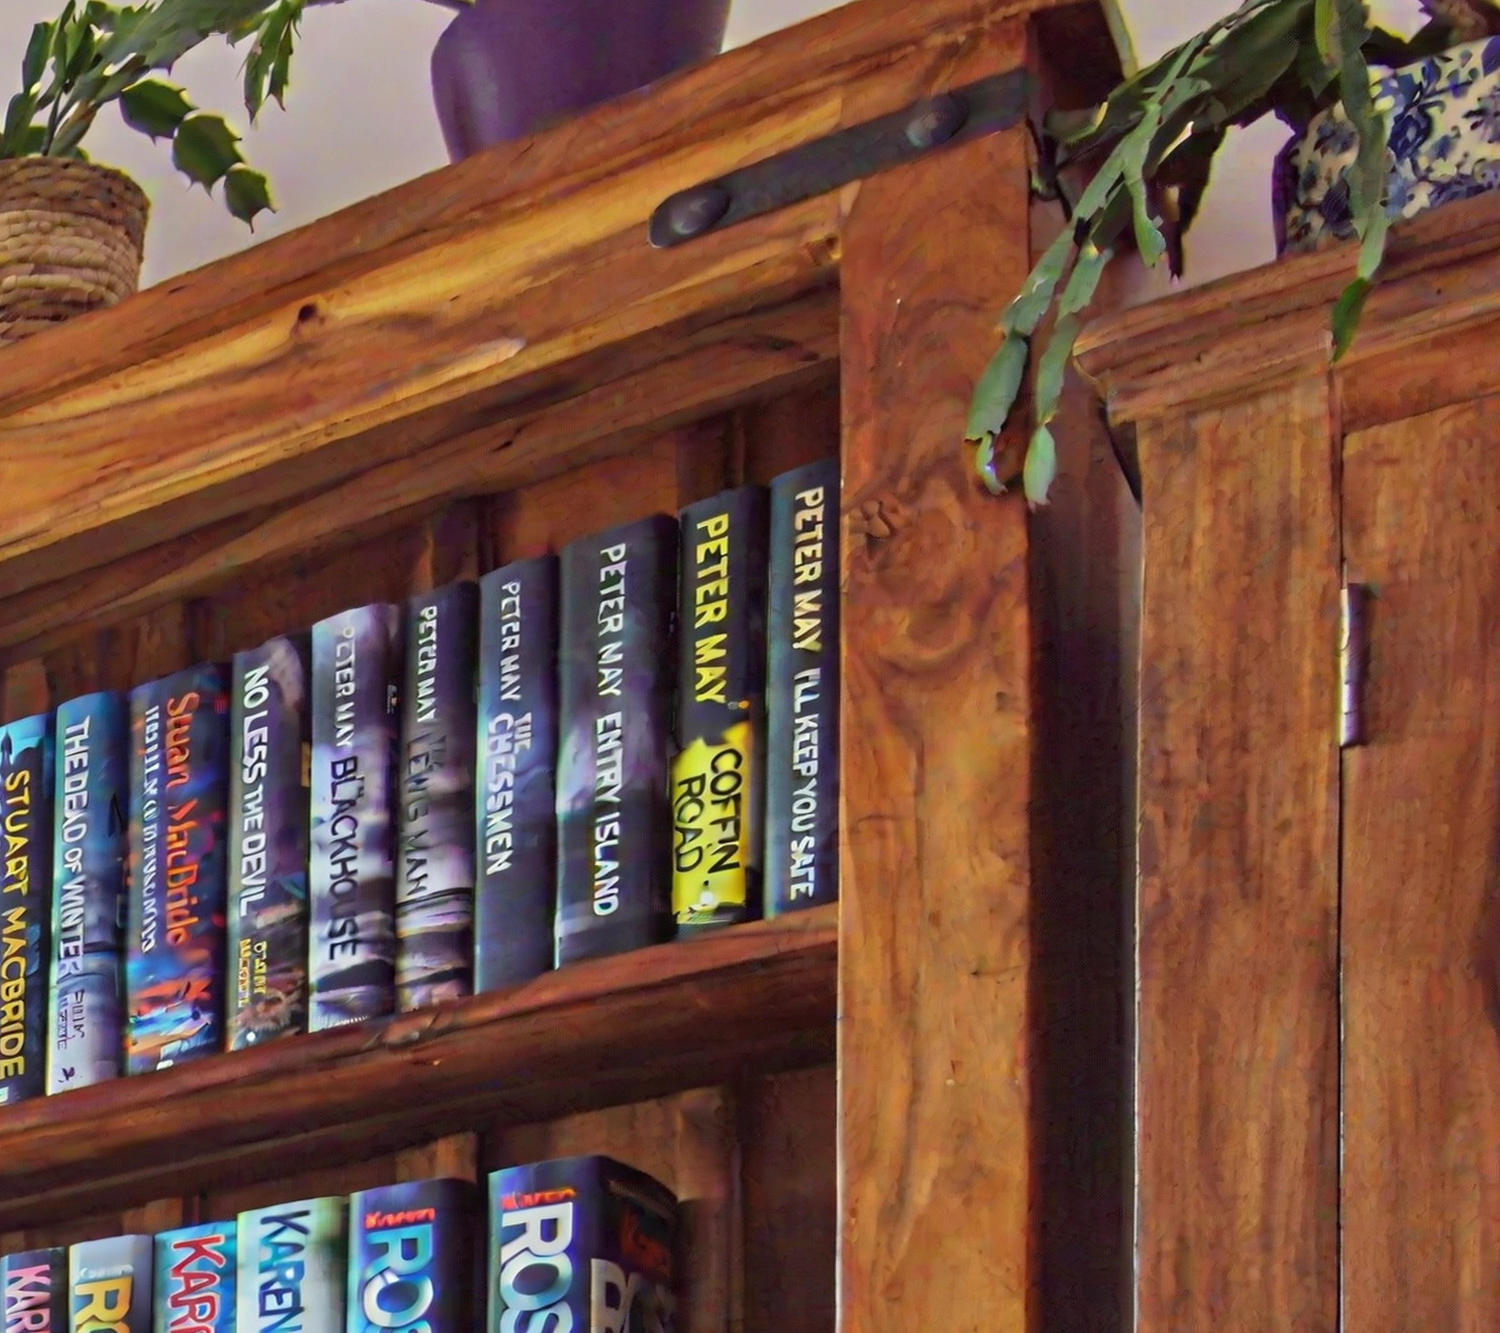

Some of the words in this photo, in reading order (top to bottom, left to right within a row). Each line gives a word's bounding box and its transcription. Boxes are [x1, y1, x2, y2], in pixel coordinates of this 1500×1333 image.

[695, 513, 729, 623] PETER
[794, 487, 824, 581] PETER
[500, 582, 521, 652] PETER
[598, 543, 626, 635] PETER
[792, 589, 822, 652] MAY
[243, 665, 269, 708] NO
[416, 680, 437, 724] MAY
[499, 656, 521, 701] MAY
[597, 641, 623, 697] MAY
[694, 633, 727, 704] MAY
[65, 716, 90, 768] THE
[243, 715, 267, 784] LESS
[792, 715, 818, 776] KEEP
[63, 772, 88, 842] DEAD
[243, 786, 263, 831] THE
[485, 712, 513, 875] CHESSMEN
[674, 774, 706, 872] ROAD
[790, 780, 817, 831] YOU
[4, 769, 30, 896] STUART
[66, 849, 82, 873] OF
[329, 756, 358, 960] BLACKHOUSE
[593, 812, 620, 916] ISLAND
[240, 835, 266, 917] DEVIL
[59, 876, 85, 977] WINTER
[0, 906, 27, 1079] MACBRIDE
